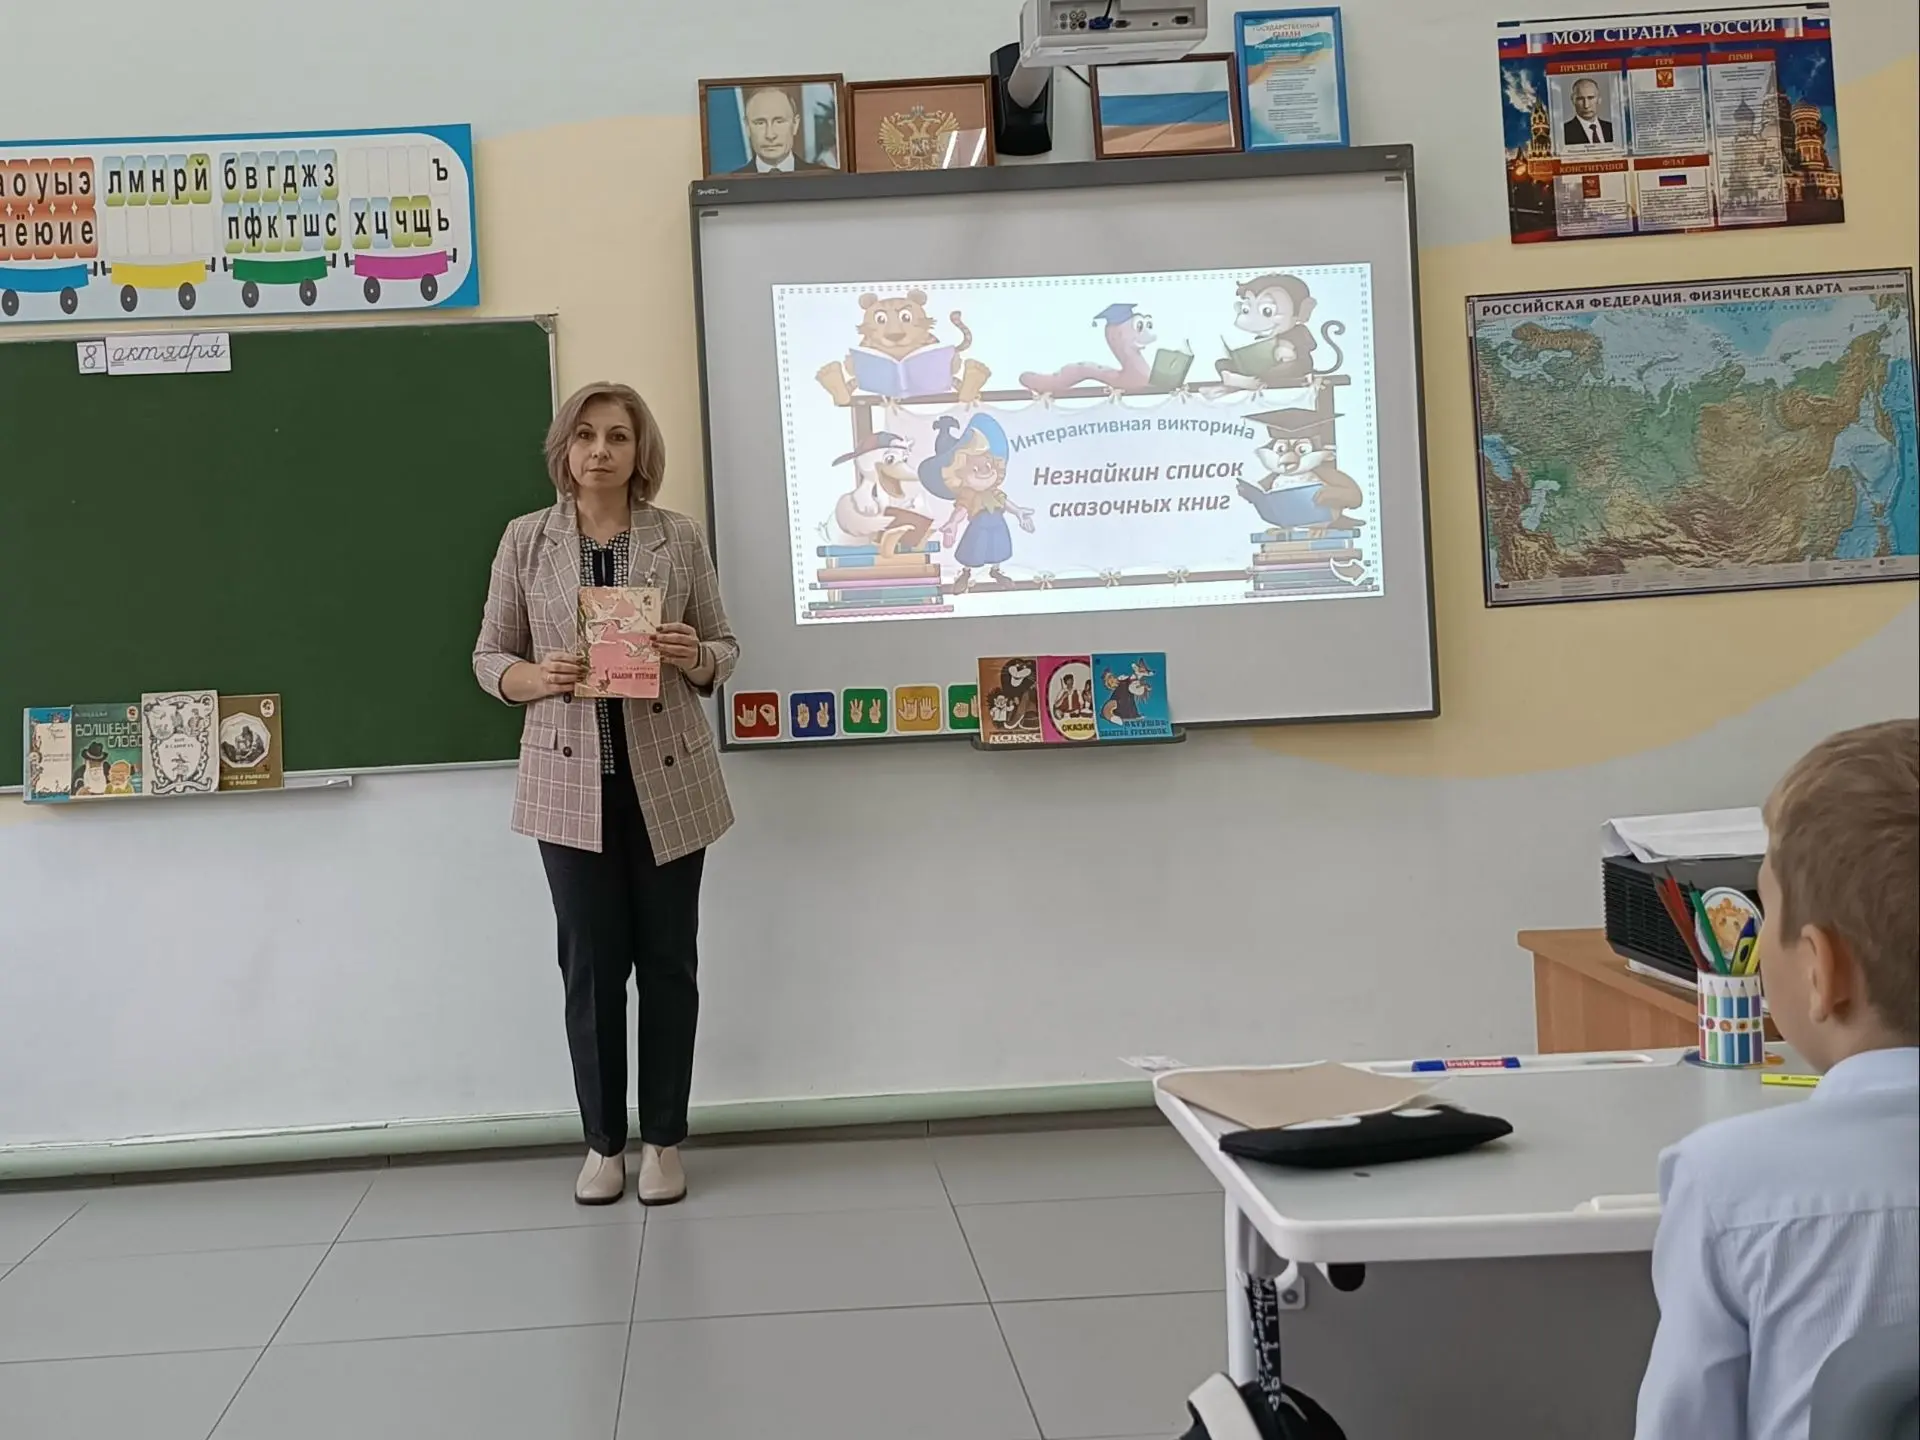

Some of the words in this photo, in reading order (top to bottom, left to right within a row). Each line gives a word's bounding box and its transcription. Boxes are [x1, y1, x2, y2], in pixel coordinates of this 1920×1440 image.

[1552, 30, 1595, 46] МОЯ
[1603, 25, 1679, 42] СТРАНА
[1700, 18, 1776, 37] РОССИЯ
[1662, 158, 1686, 166] ФЛАГ
[1482, 297, 1585, 316] РОССИЙСКАЯ
[1589, 292, 1687, 308] ФЕДЕРАЦИЯ.
[1689, 284, 1791, 301] ФИЗИЧЕСКАЯ
[1795, 282, 1843, 296] КАРТА
[83, 345, 97, 369] 8
[1010, 417, 1151, 453] Интерактивная
[1157, 417, 1255, 440] викторина
[1033, 463, 1159, 487] Незнайкин
[1166, 461, 1244, 481] список
[1050, 497, 1171, 518] сказочных
[1178, 495, 1231, 512] книг
[75, 721, 142, 736] ВОЛШЕБНО
